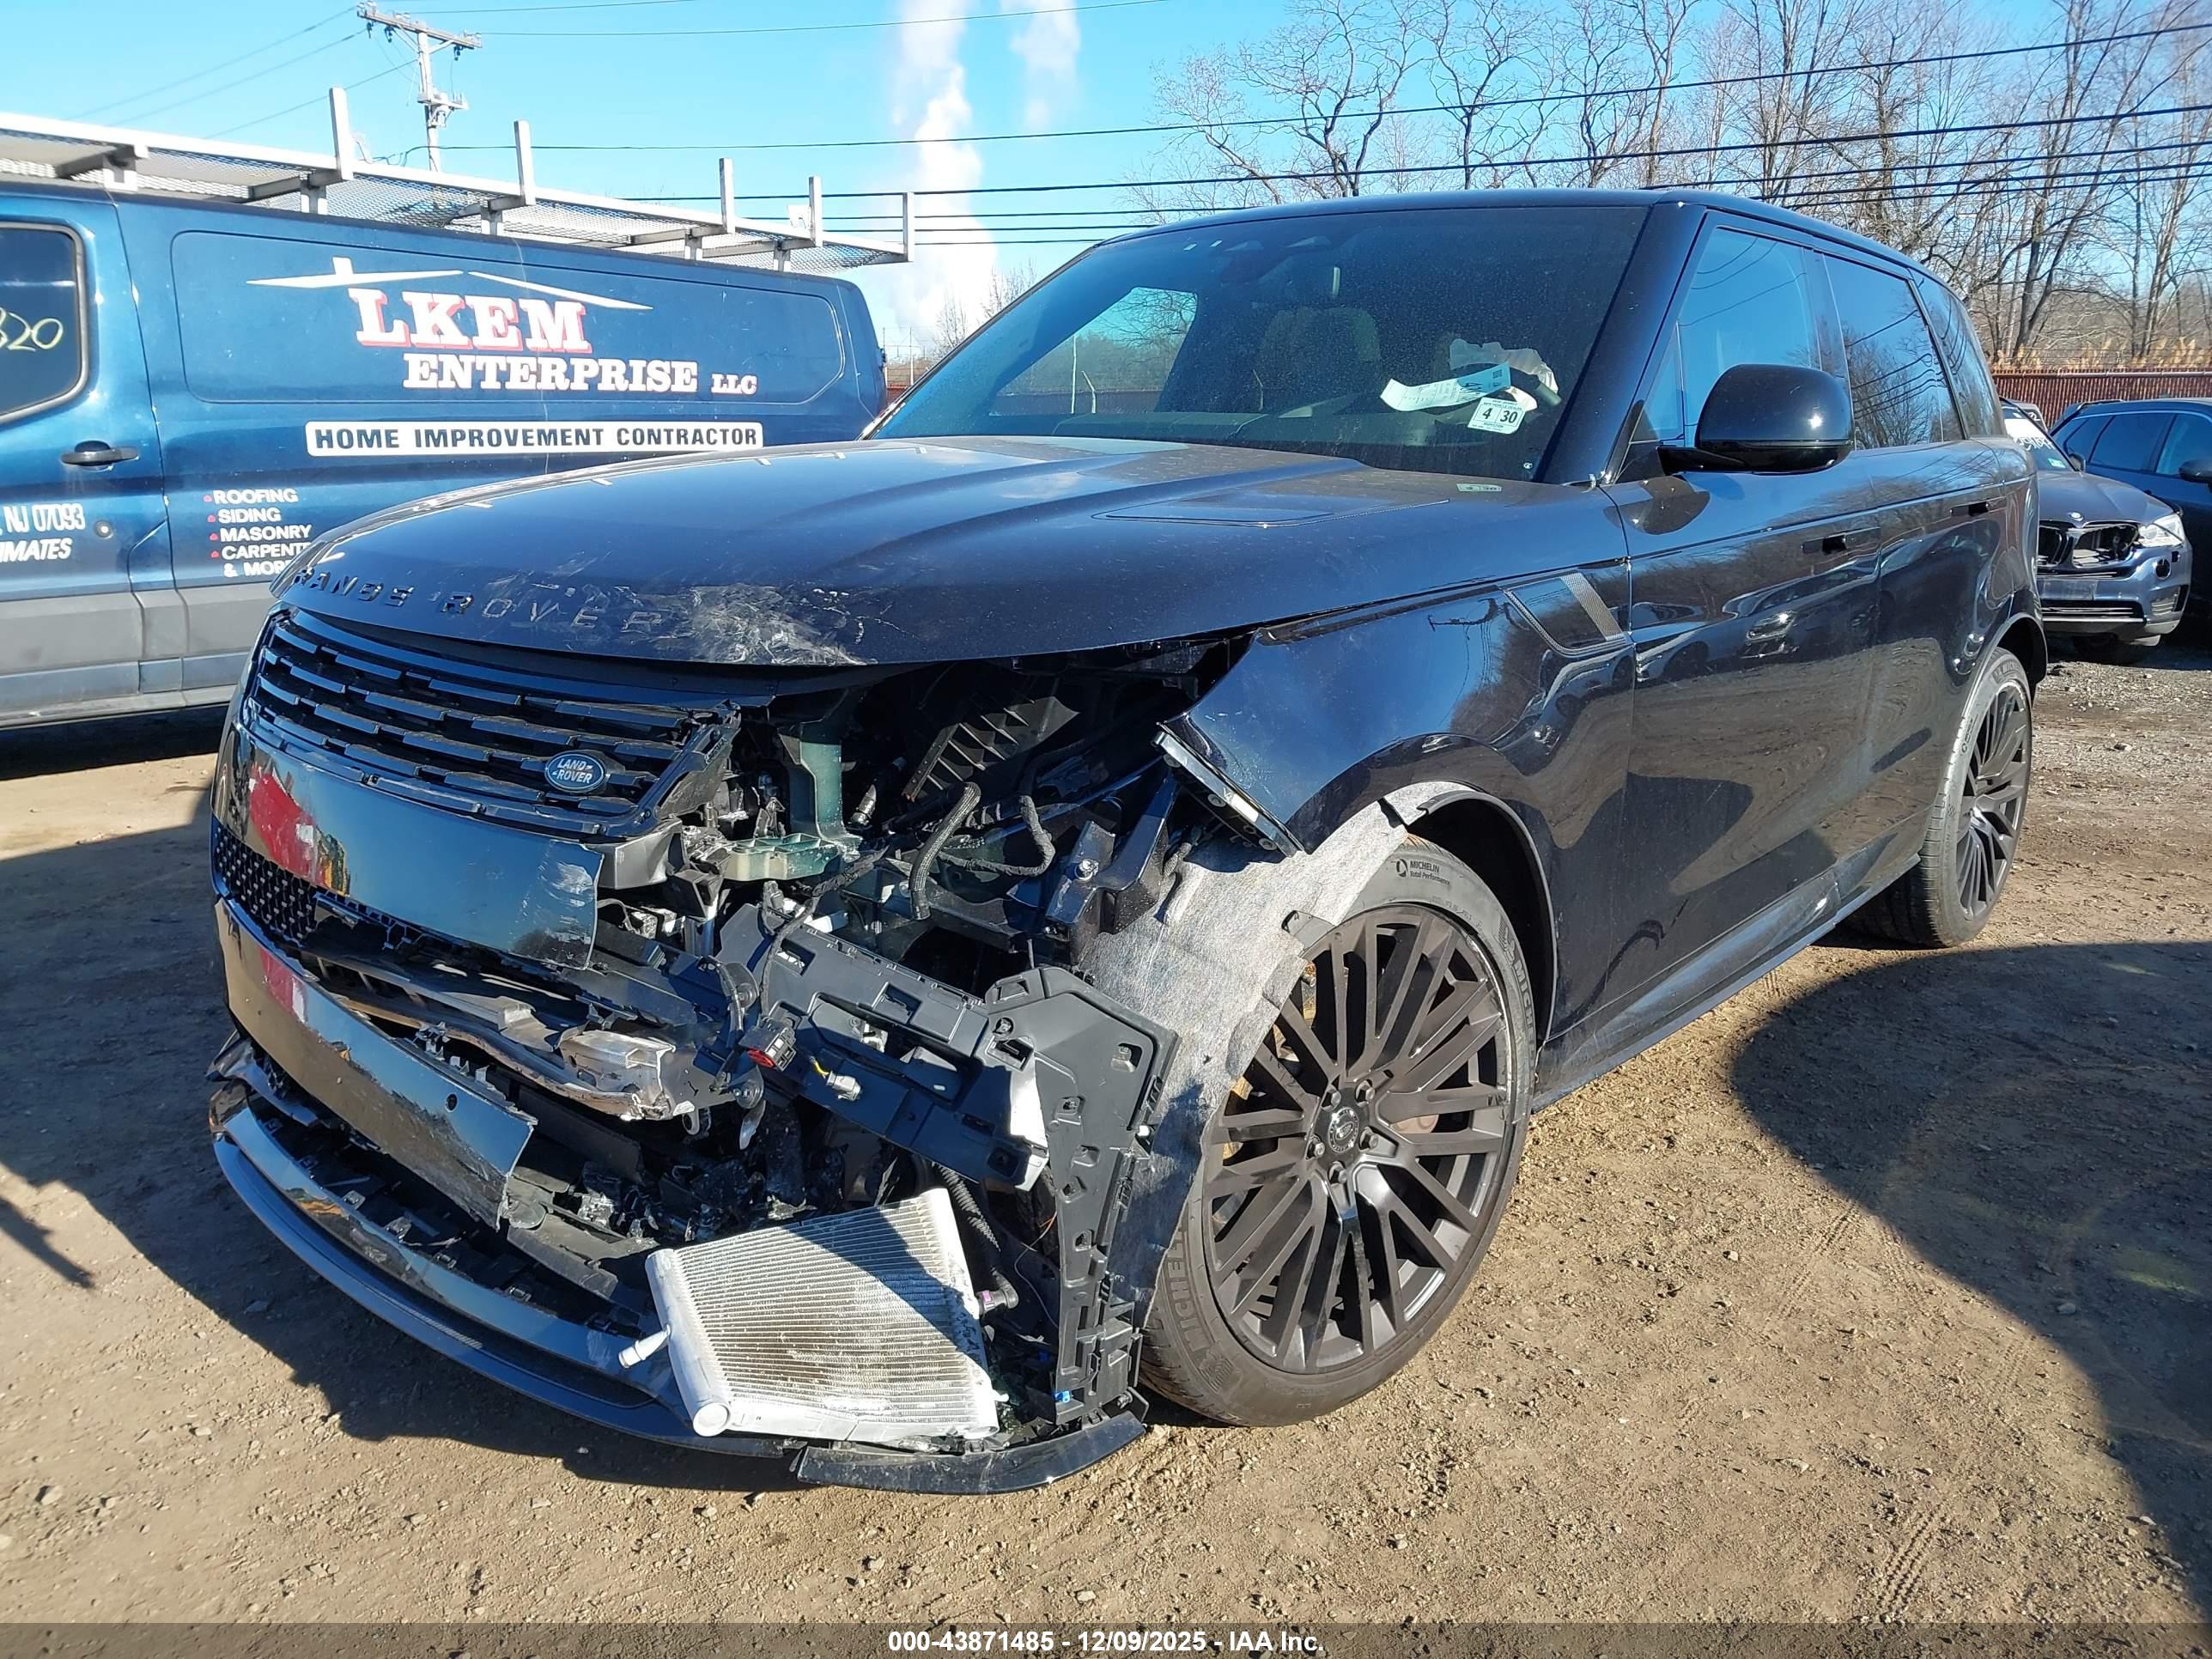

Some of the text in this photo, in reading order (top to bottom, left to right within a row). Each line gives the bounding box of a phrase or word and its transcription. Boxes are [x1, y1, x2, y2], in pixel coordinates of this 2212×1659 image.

[347, 288, 592, 354] LKEM
[403, 353, 757, 395] ENTERPRISE LLC
[1482, 408, 1518, 423] 4 30
[314, 427, 757, 449] HOME IMPROVEMENT CONTRACTOR
[212, 488, 298, 504] ROOFING
[3, 502, 86, 533] NJ 07093
[218, 507, 282, 524] SIDING
[220, 524, 313, 543] MASONRY
[223, 562, 239, 578] &
[293, 566, 662, 633] RANGE ROVER
[557, 758, 587, 771] LAND
[556, 769, 592, 784] ROVER
[1410, 860, 1439, 873] MICHELIN
